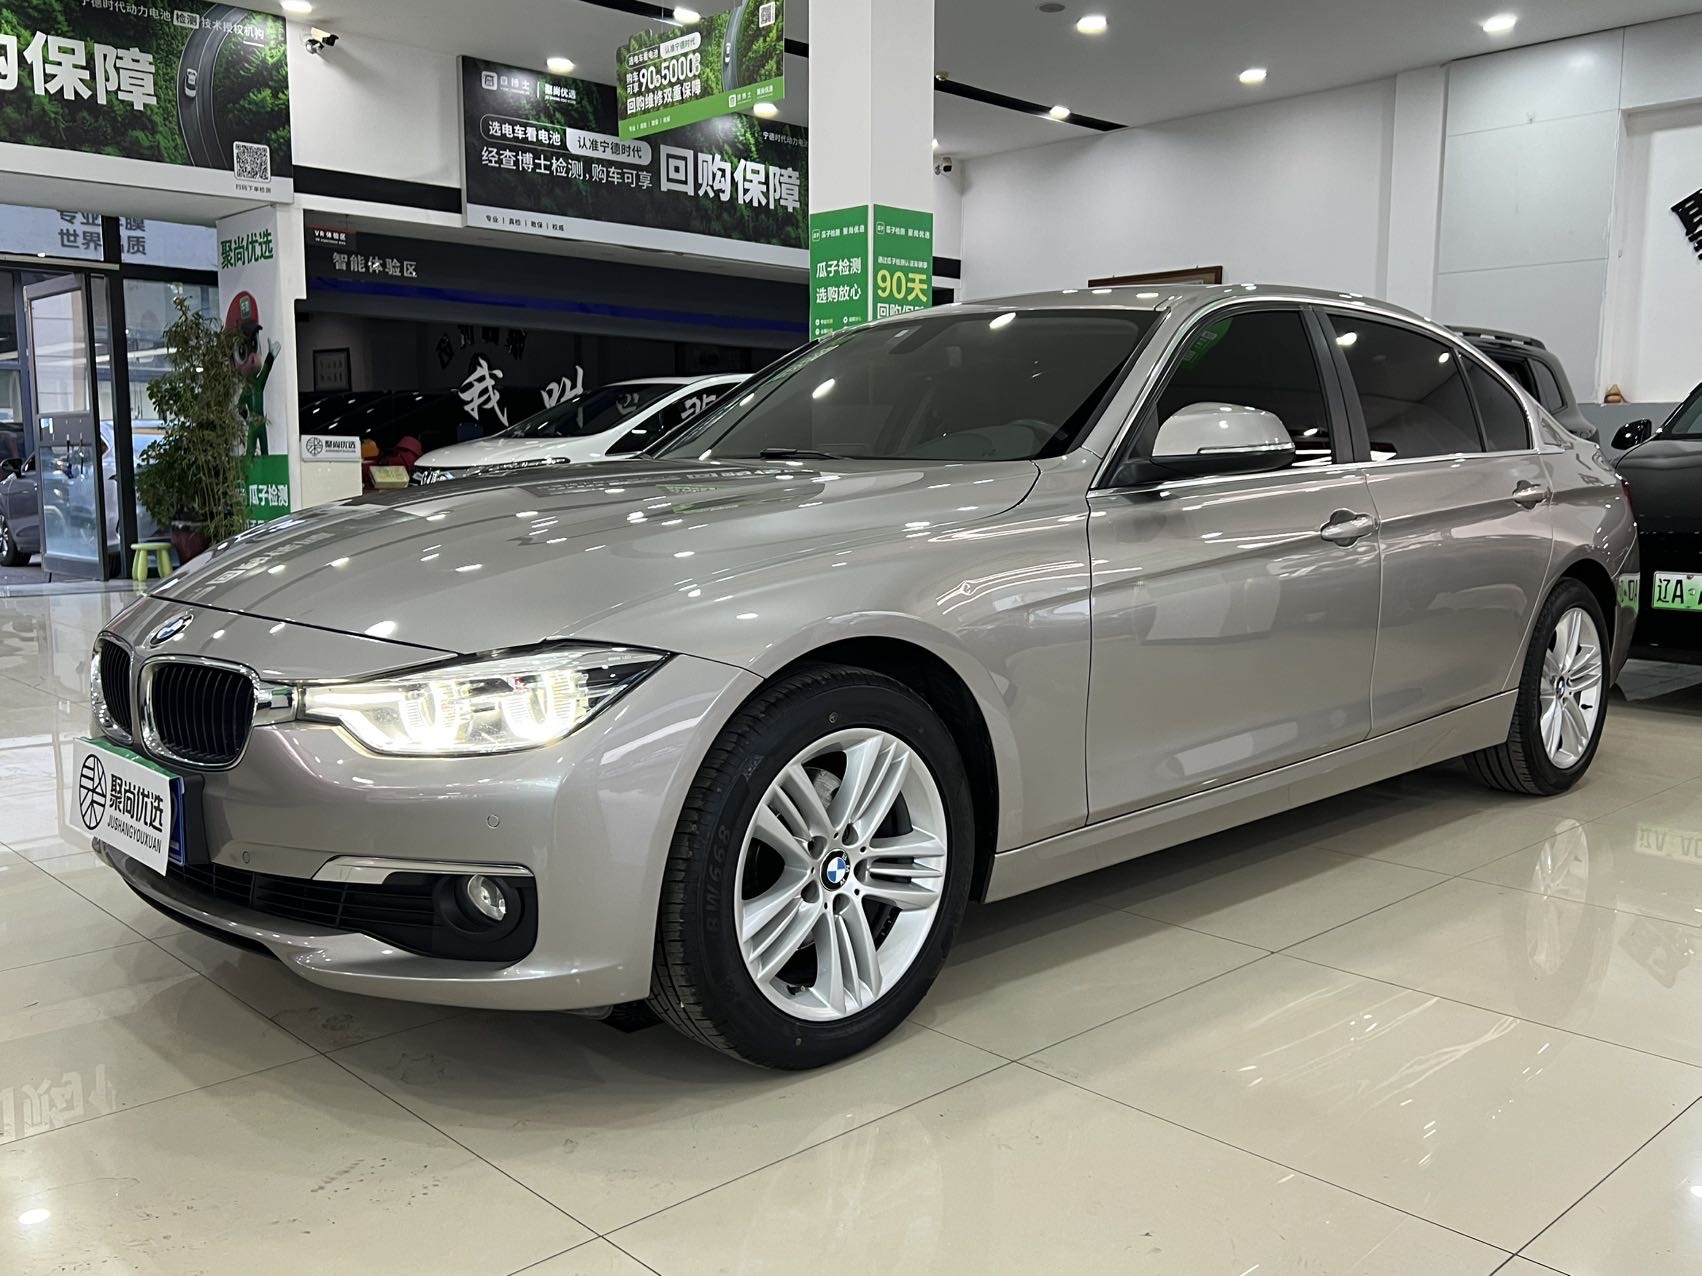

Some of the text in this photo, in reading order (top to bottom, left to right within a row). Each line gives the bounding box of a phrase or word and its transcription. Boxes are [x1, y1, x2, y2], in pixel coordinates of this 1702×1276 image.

[176, 12, 198, 28] 检测
[627, 78, 701, 115] 回购维修双重保障
[489, 120, 643, 159] 选电车看电池 认准宁德时代
[762, 131, 808, 147] 宁德时代动力电
[660, 144, 800, 212] 回购保障
[56, 209, 145, 232] 专业膜
[58, 228, 146, 256] 世界质
[221, 228, 274, 270] 聚尚优选
[332, 252, 418, 278] 智能体验区
[816, 257, 862, 278] 瓜子检测
[816, 283, 862, 304] 选购放心
[877, 269, 928, 303] 90天
[877, 303, 925, 319] 回购
[249, 484, 289, 507] 瓜子检测
[109, 773, 164, 833] 聚尚优选
[107, 814, 162, 854] JUSHANGYOUXUAN
